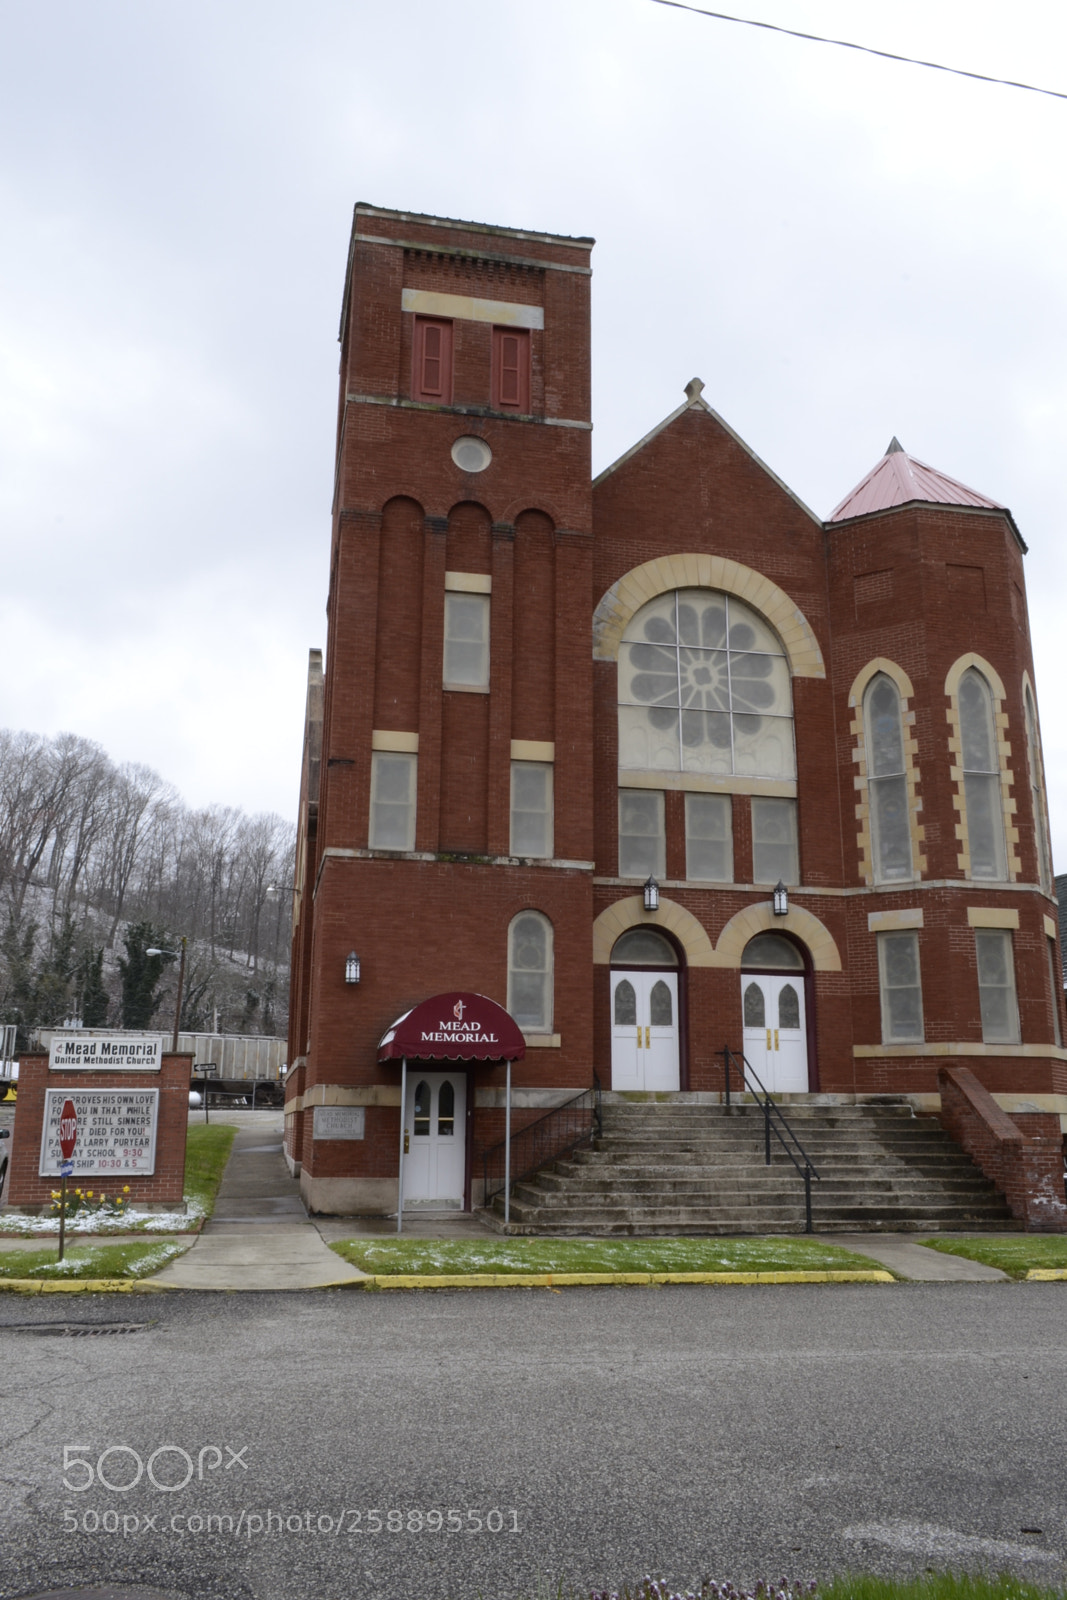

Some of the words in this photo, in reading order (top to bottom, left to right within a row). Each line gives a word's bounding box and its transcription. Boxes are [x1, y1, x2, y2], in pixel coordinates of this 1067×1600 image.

[439, 1021, 481, 1031] MEAD
[421, 1032, 499, 1043] MEMORIAL
[65, 1042, 97, 1055] Mead
[101, 1042, 157, 1055] Memorial
[54, 1056, 81, 1064] United
[84, 1056, 124, 1065] Methodist
[126, 1056, 156, 1065] Church
[103, 1096, 116, 1104] HIS
[117, 1096, 134, 1104] OWN
[135, 1096, 154, 1104] LOVE
[52, 1106, 62, 1115] FO
[90, 1106, 98, 1115] IN
[102, 1106, 121, 1115] THAT
[126, 1106, 150, 1115] WHILE
[92, 1117, 113, 1125] STILL
[118, 1117, 151, 1125] SINNERS
[61, 1118, 77, 1141] STOP
[89, 1127, 107, 1136] DIED
[110, 1127, 125, 1136] FOR
[127, 1127, 145, 1136] YOU!
[84, 1138, 109, 1147] LARRY
[114, 1138, 150, 1147] PURYEAR
[51, 1149, 84, 1158] SUAY
[87, 1149, 116, 1158] SCHOOL
[123, 1149, 143, 1158] 9:30
[56, 1160, 95, 1168] WRSHIP
[98, 1160, 121, 1168] 10:30
[124, 1160, 129, 1168] &
[132, 1160, 137, 1168] 5
